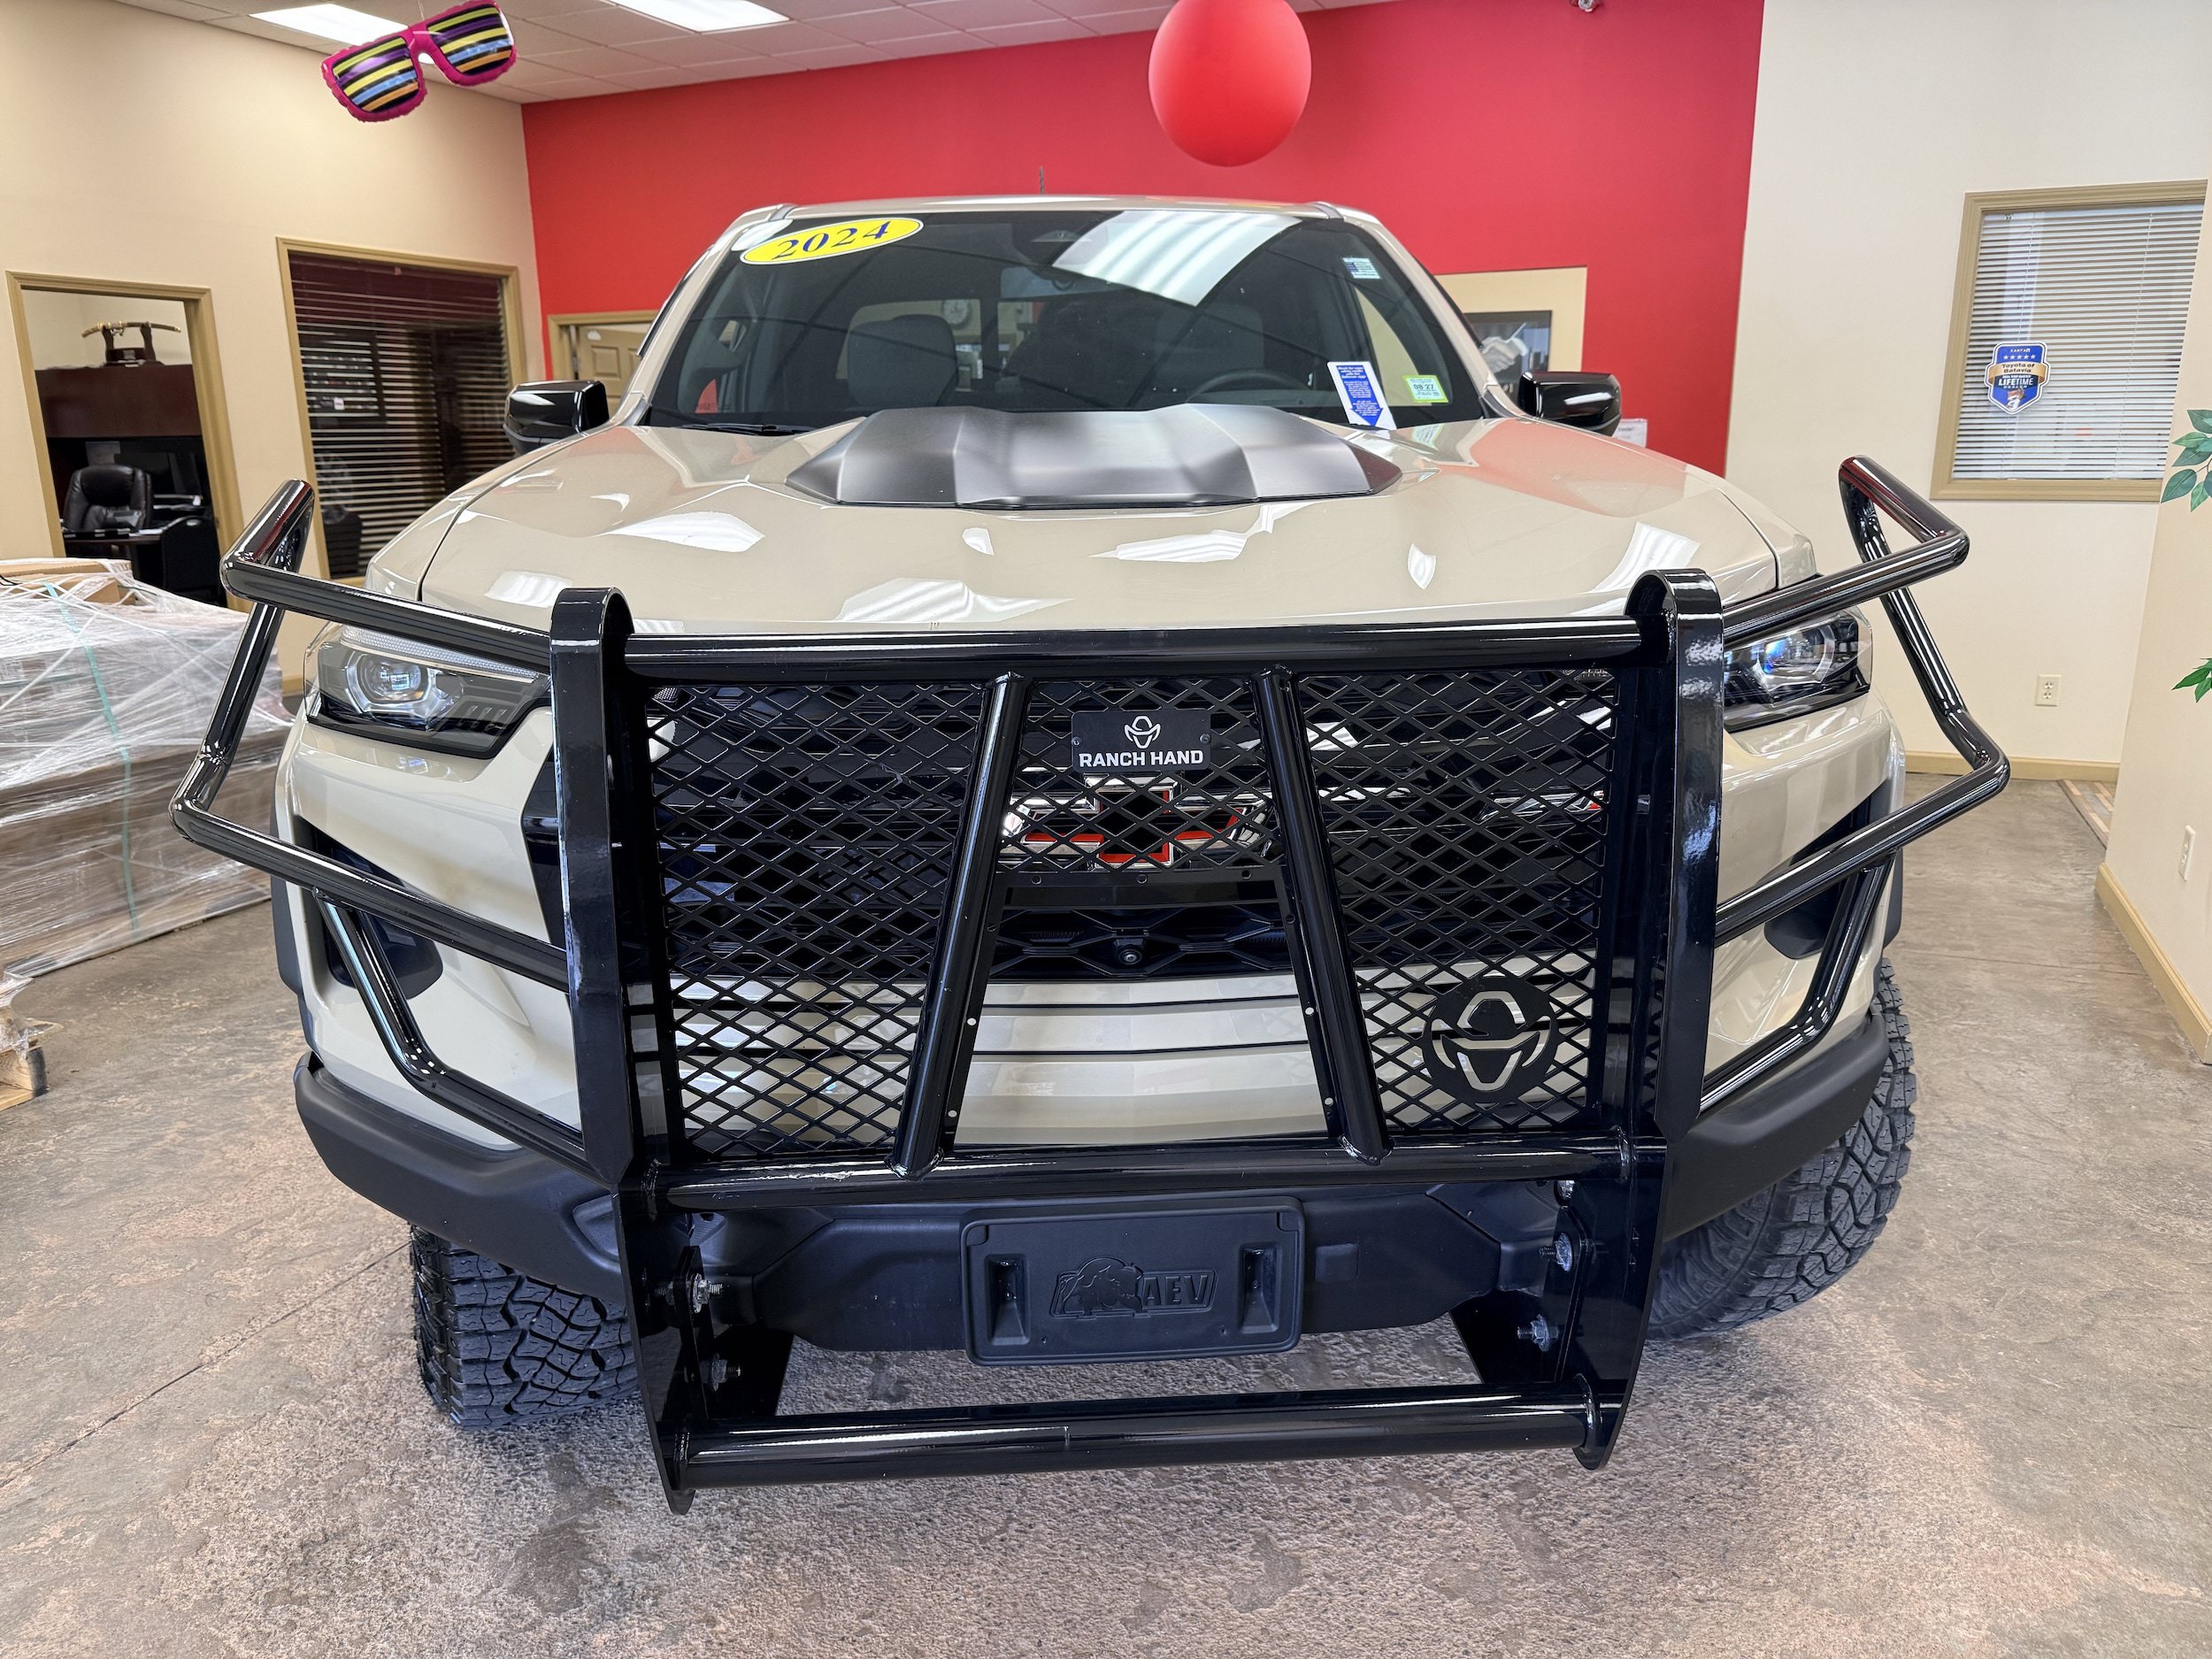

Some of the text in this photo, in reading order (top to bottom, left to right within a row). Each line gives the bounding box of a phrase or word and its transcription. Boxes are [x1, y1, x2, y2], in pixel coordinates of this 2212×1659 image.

[772, 220, 891, 261] 2024
[1079, 749, 1203, 768] RANCH HAND
[1144, 1274, 1209, 1306] AEV
